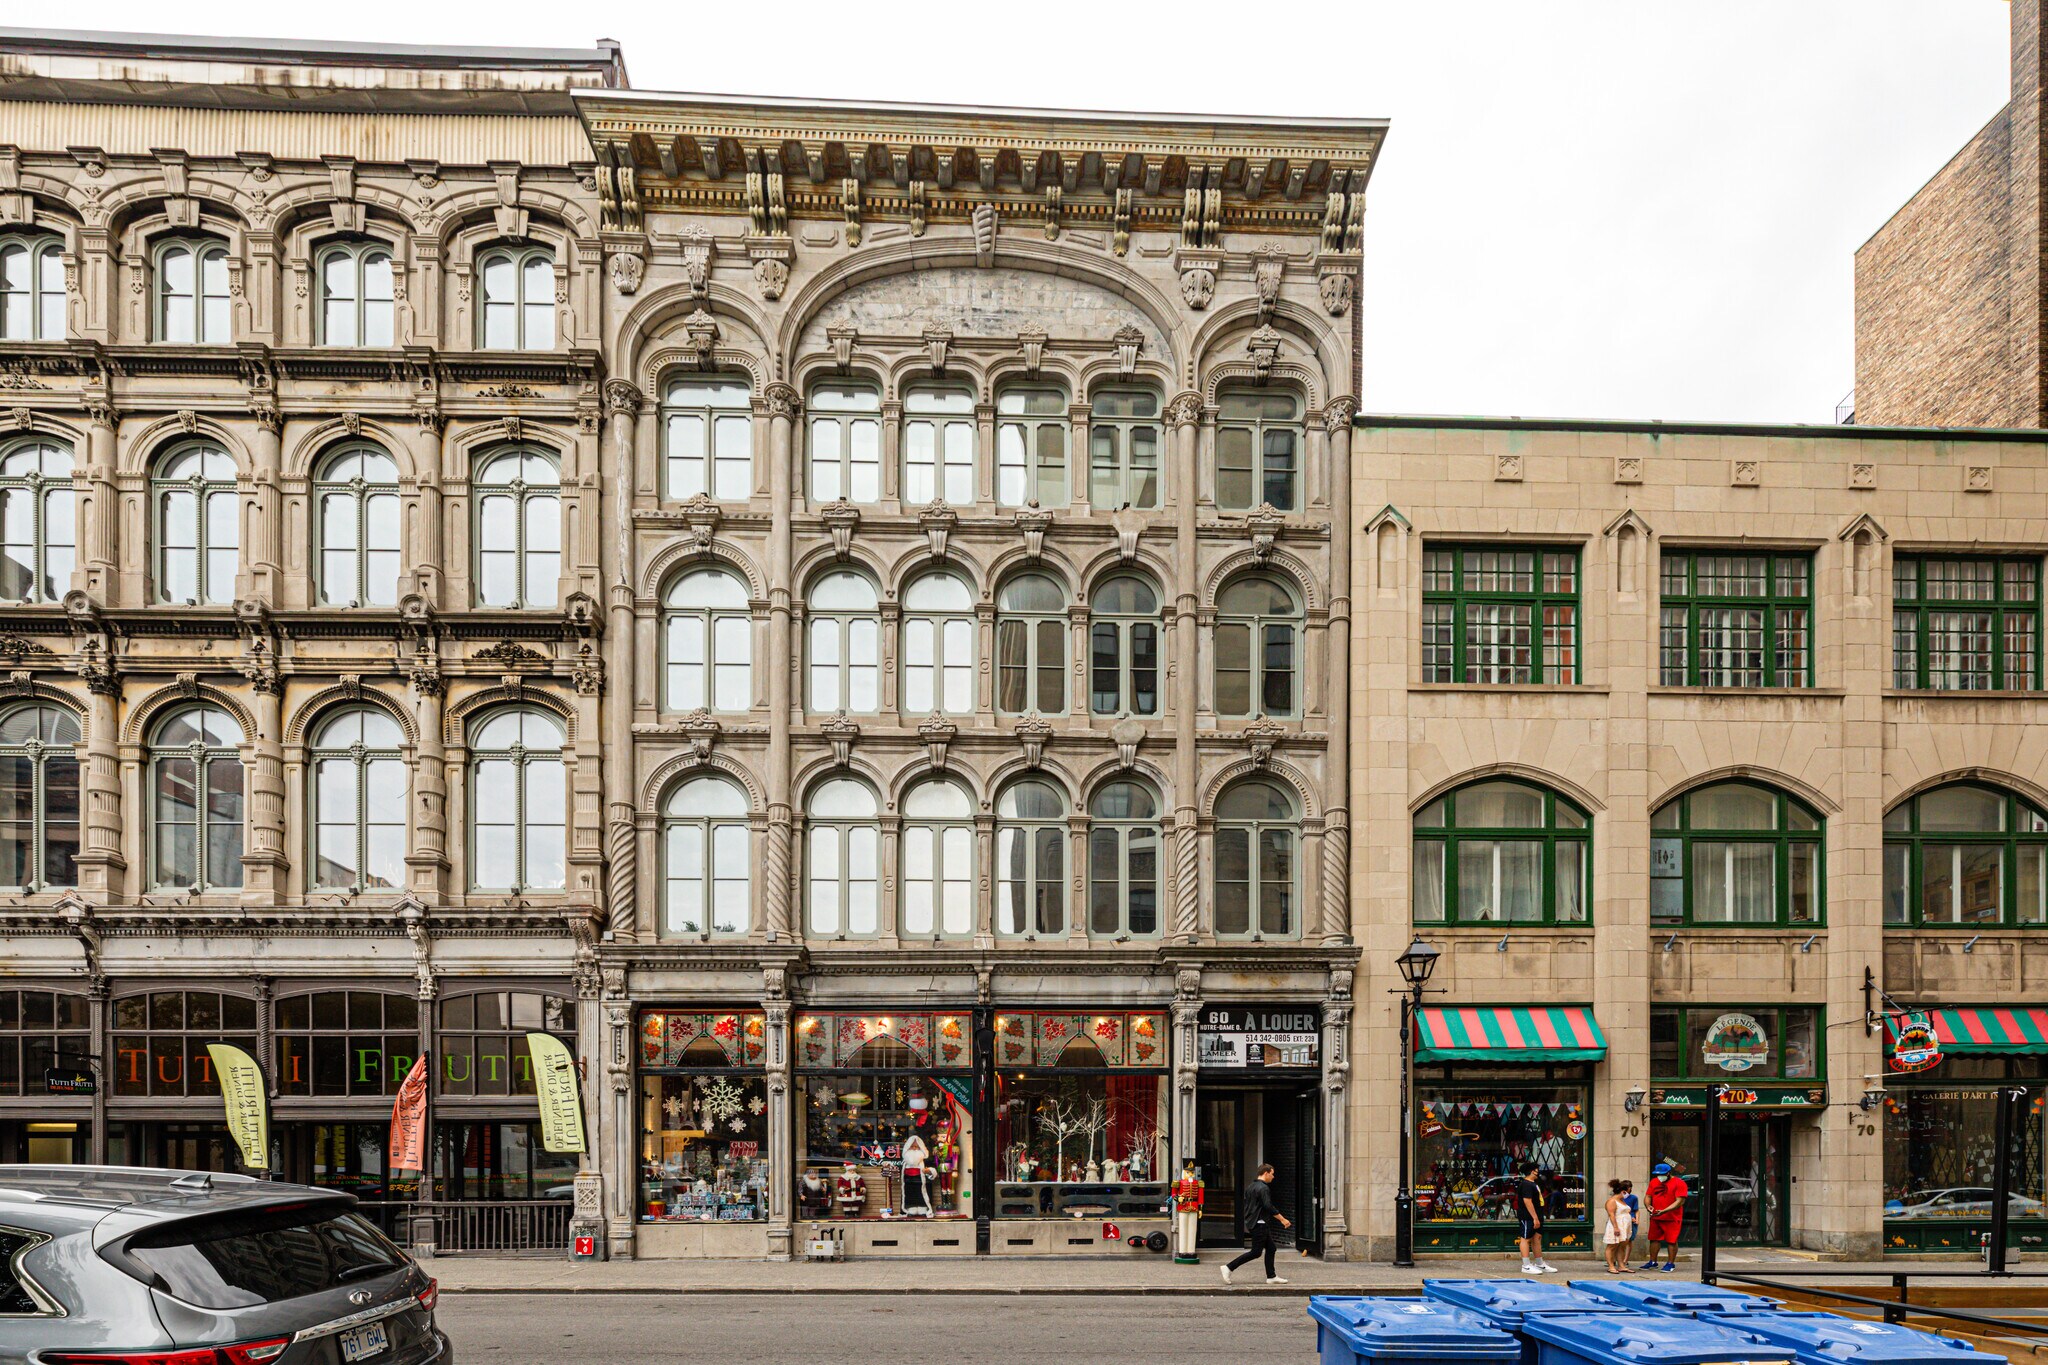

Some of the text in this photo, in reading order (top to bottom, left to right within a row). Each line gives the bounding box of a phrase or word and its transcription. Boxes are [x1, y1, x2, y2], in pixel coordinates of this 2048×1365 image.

[1209, 1012, 1229, 1024] 60
[1245, 1012, 1315, 1031] À LOUER
[1260, 1035, 1291, 1043] 342-0805
[118, 1049, 534, 1083] TUTI FRUTT
[1728, 1090, 1745, 1102] 70
[1922, 1092, 1960, 1100] GALERIE
[1962, 1091, 1988, 1100] D'ART
[1621, 1126, 1639, 1138] 70
[1857, 1124, 1875, 1136] 70
[342, 1336, 362, 1357] 761
[366, 1328, 386, 1348] GWL
